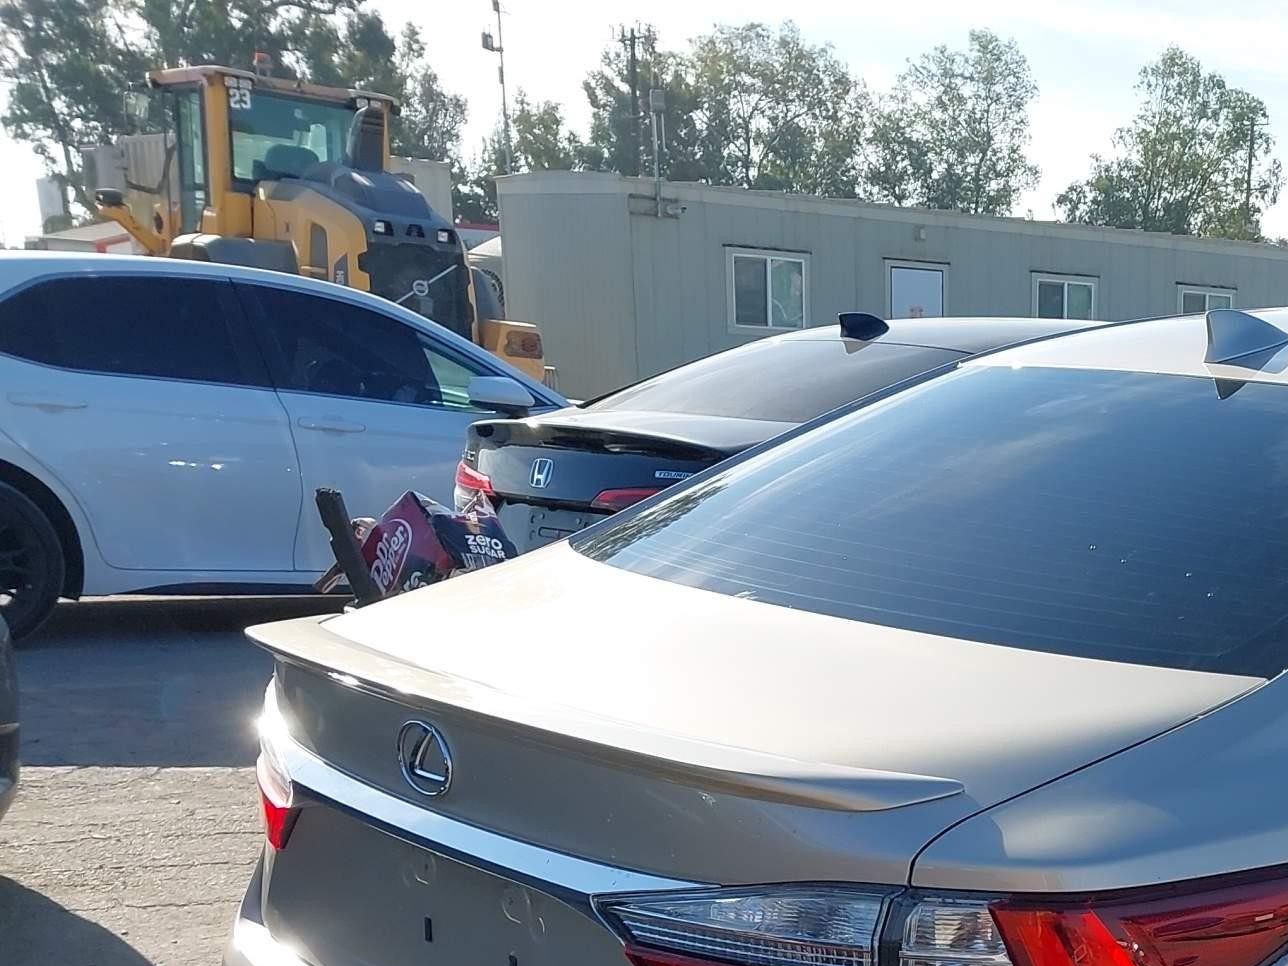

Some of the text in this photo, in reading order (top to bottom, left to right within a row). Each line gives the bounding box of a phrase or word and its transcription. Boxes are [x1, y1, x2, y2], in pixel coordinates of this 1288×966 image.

[229, 89, 252, 109] 23
[376, 532, 392, 567] Dr
[465, 534, 503, 550] zero
[469, 545, 506, 559] SUGAR
